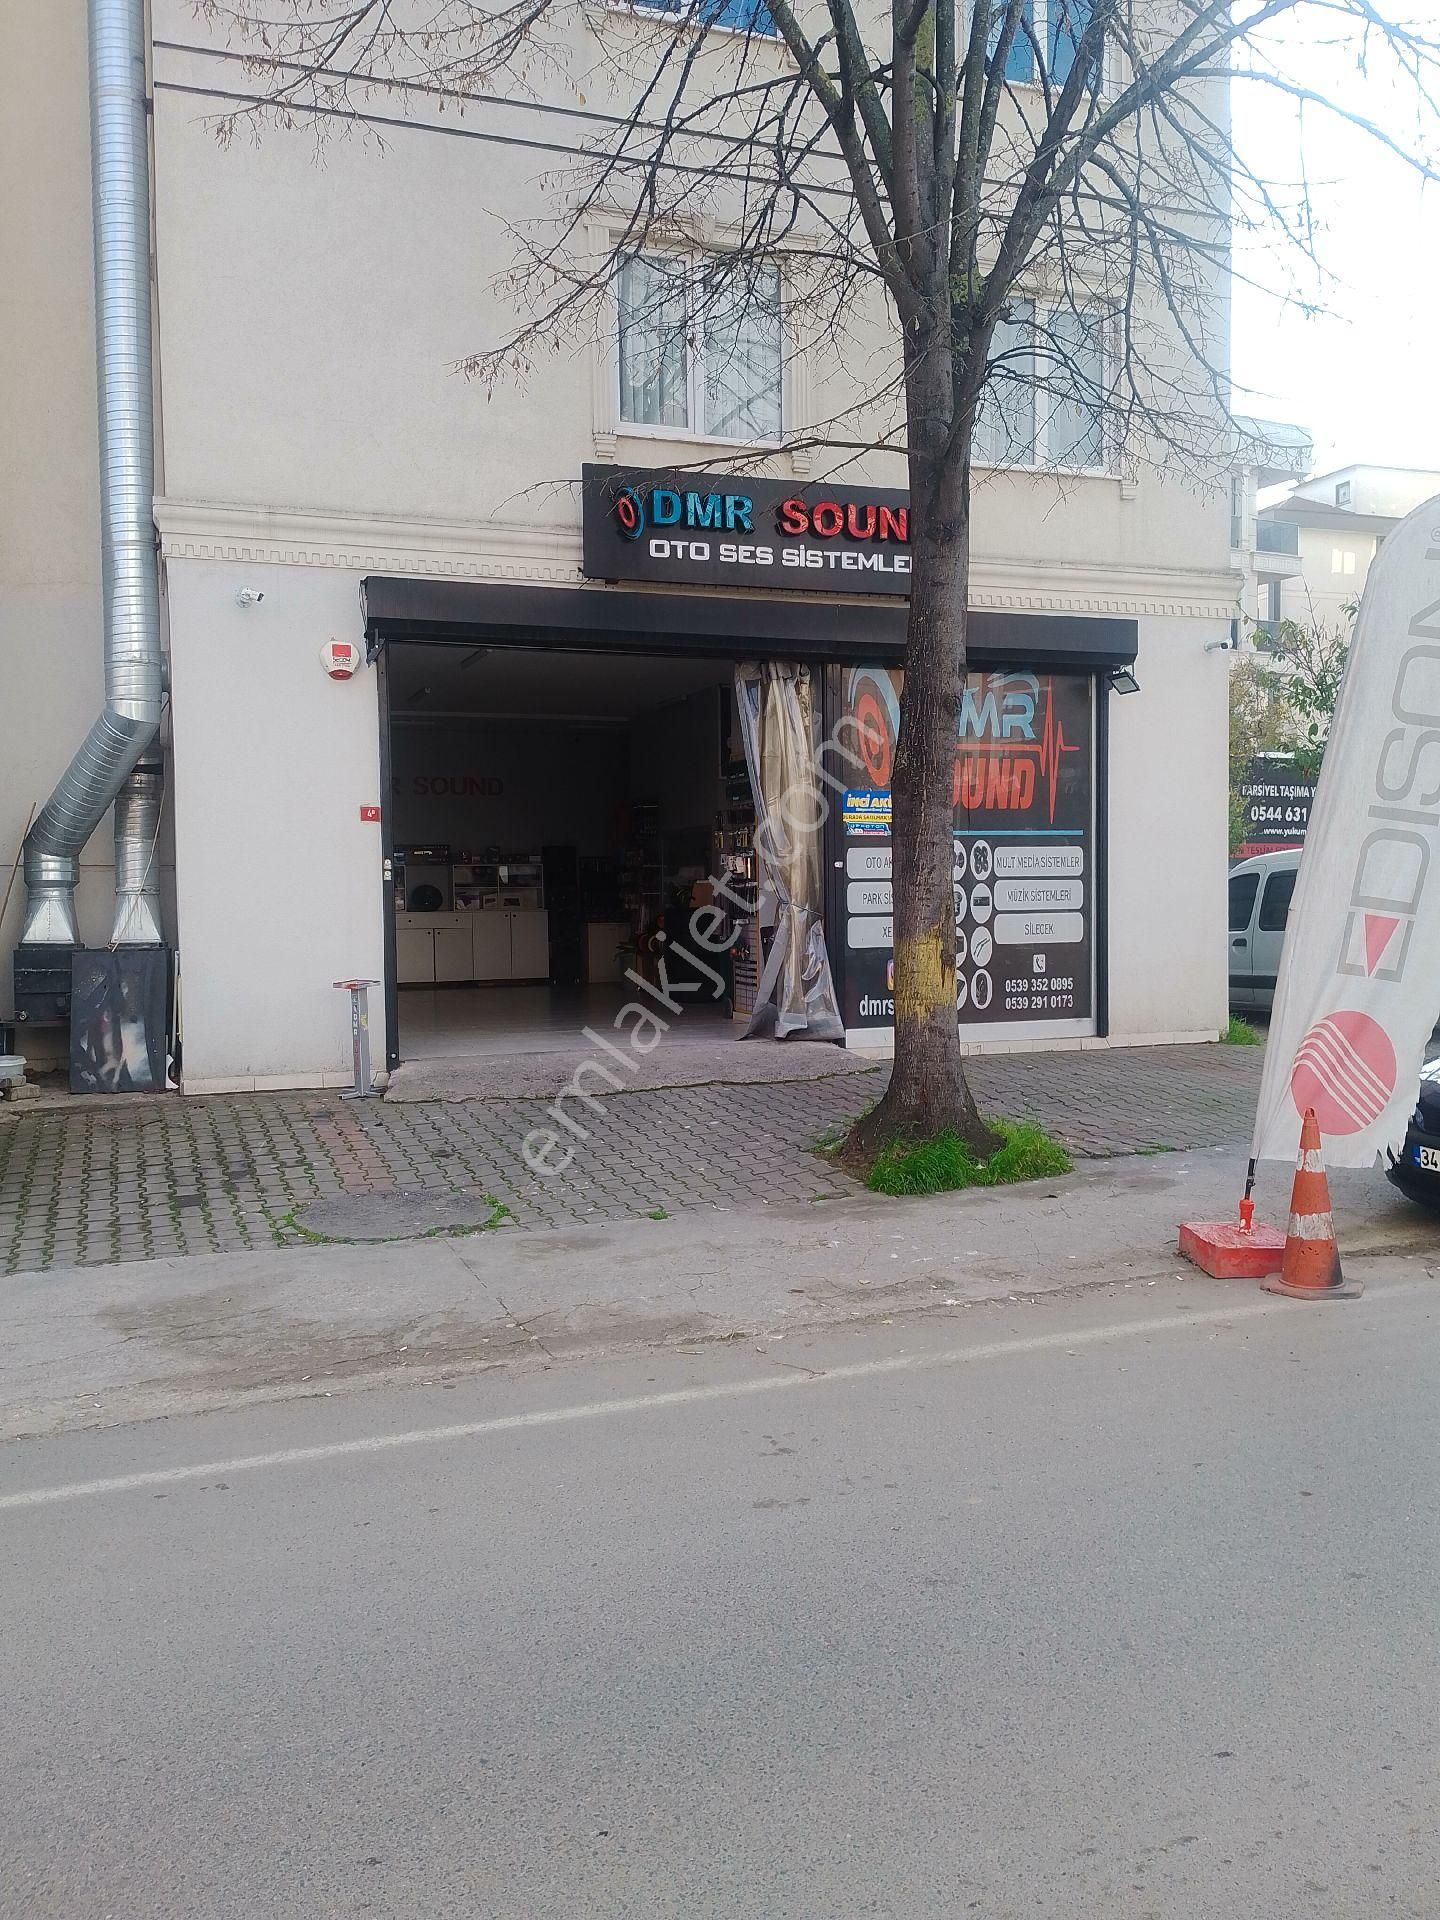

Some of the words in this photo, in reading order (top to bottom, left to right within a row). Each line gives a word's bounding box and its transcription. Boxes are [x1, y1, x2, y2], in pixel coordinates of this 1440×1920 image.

[653, 488, 755, 532] DMR
[780, 498, 908, 541] SOUN
[649, 539, 710, 561] OTO
[719, 544, 774, 565] SES
[782, 544, 913, 574] SİSTEMLE
[958, 690, 1036, 738] MR
[413, 775, 504, 797] SOUND
[952, 757, 1036, 810] UND
[1280, 785, 1310, 800] TAŞIMA
[1250, 805, 1283, 821] 0544
[1285, 806, 1308, 822] 631
[866, 857, 882, 869] OTO
[862, 892, 883, 905] PARK
[1007, 888, 1030, 902] MÜZİK
[882, 926, 892, 938] XE
[1024, 921, 1054, 935] SİLECEK
[1005, 979, 1029, 992] 0539
[1031, 978, 1049, 992] 352
[1050, 977, 1074, 991] 0895
[859, 994, 895, 1017] dmrs
[1005, 997, 1029, 1010] 0539
[1031, 996, 1048, 1009] 291
[1050, 994, 1074, 1008] 0173
[1421, 1149, 1438, 1169] 34
